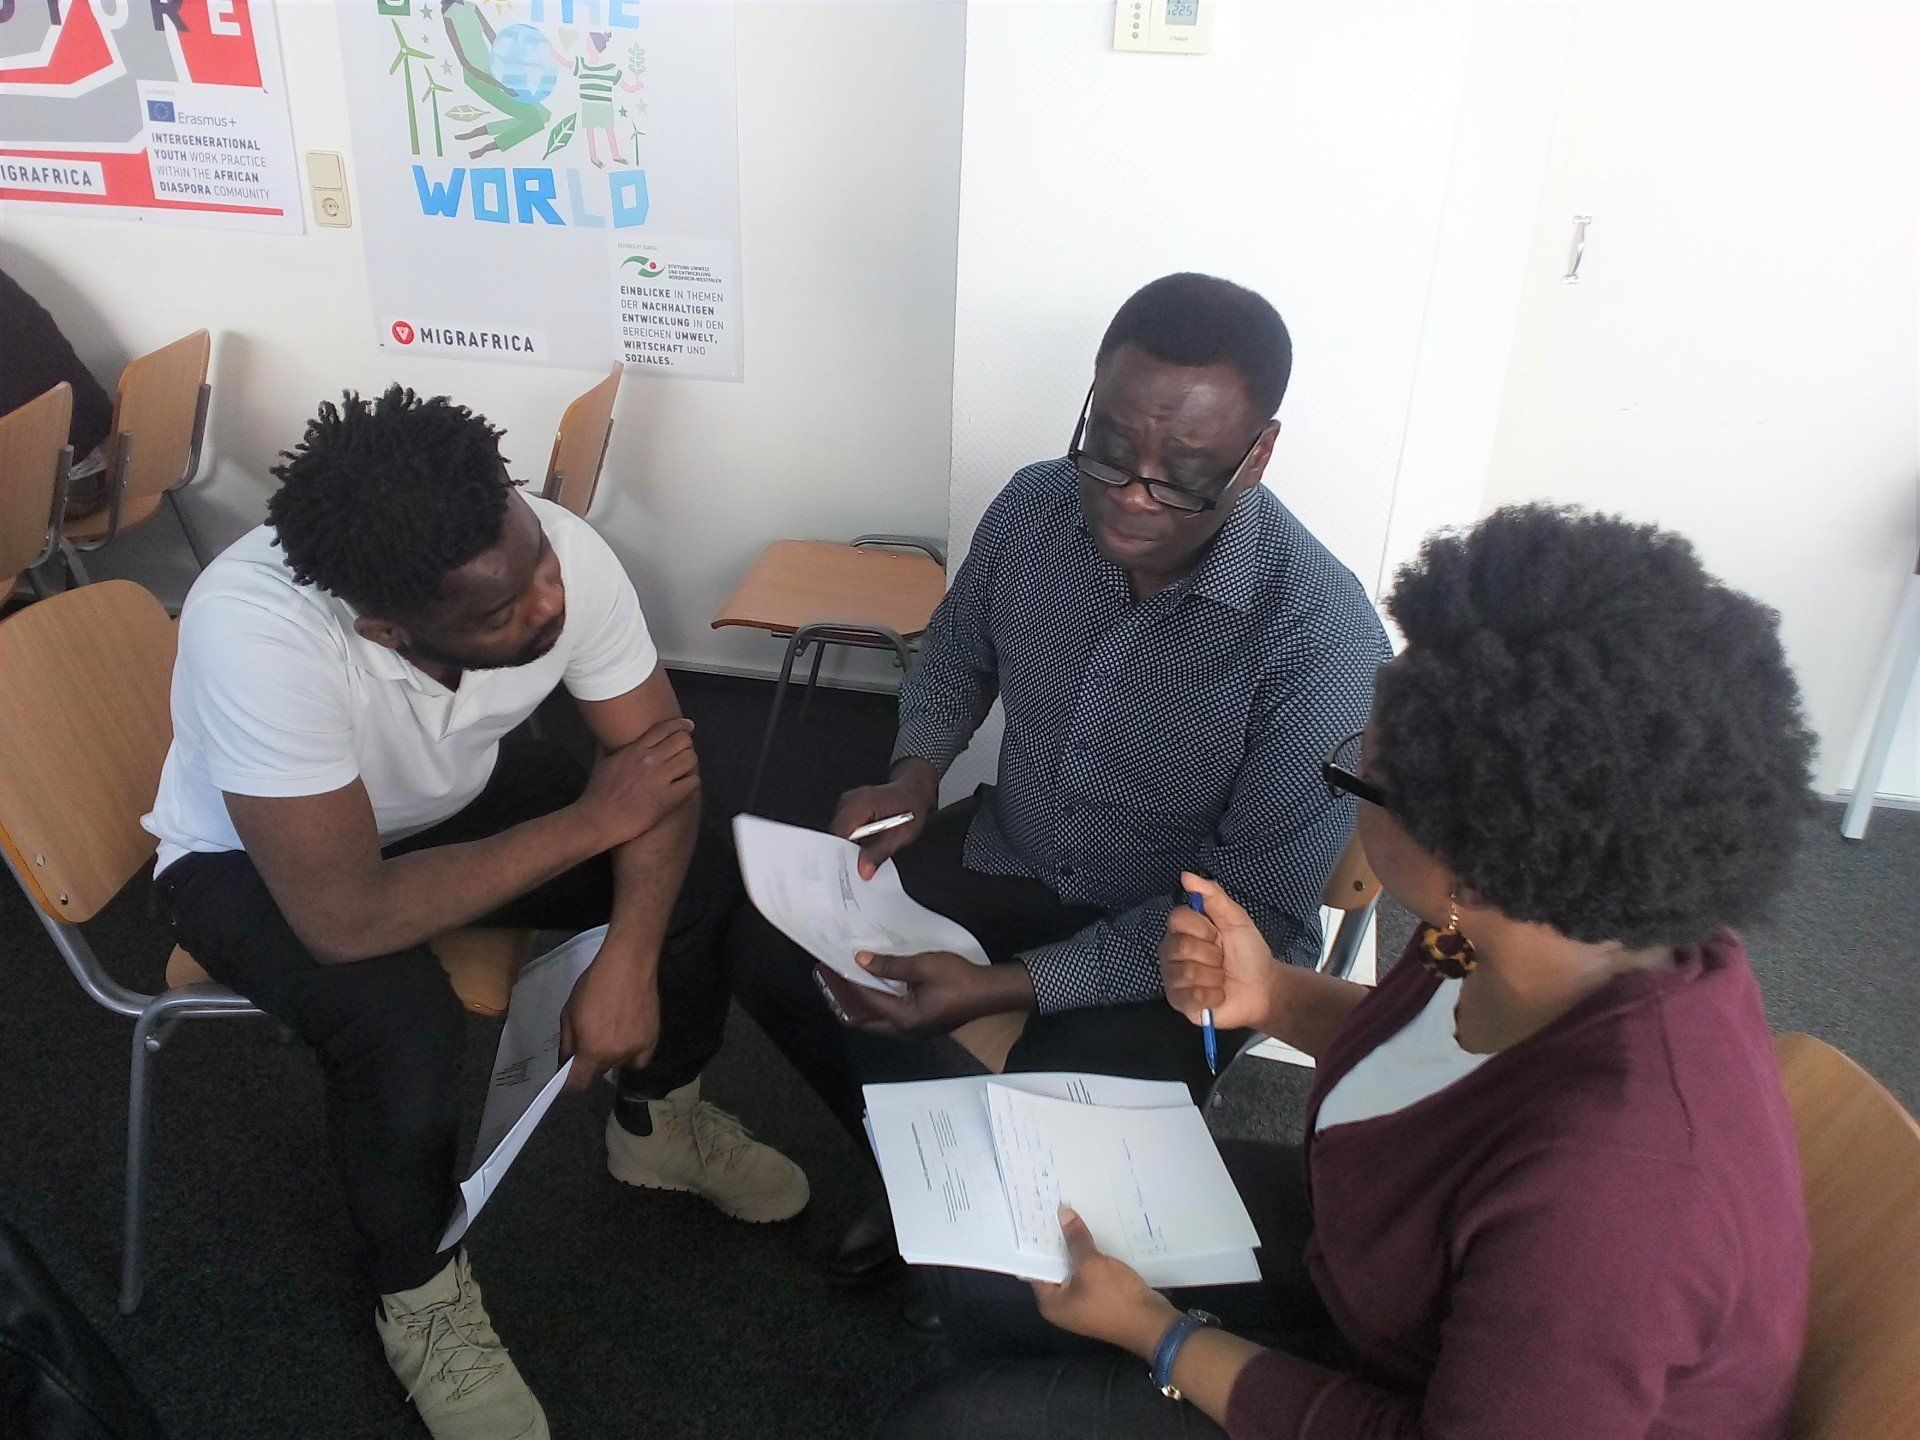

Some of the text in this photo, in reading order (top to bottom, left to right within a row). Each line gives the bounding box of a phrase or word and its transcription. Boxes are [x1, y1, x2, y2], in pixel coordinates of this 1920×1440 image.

[178, 112, 237, 127] Erasmus+
[151, 132, 261, 151] INTERGENERATIONAL
[154, 149, 267, 168] YOUTH WORK PRACTICE
[156, 165, 260, 183] WITHIN THE AFRICAN
[160, 181, 270, 200] DIASPORA COMMUNITY
[411, 164, 650, 229] WORLD
[620, 285, 724, 302] EINBLICKE IN THEMEN
[621, 299, 715, 315] DER NACHHALTIGEN
[622, 313, 724, 330] ENTWICKLUNG IN DEN
[420, 326, 536, 354] MIGRAFRICA
[622, 326, 718, 344] BEREICHEN UMWELT,
[623, 340, 706, 356] WIRTSCHAFT UND
[625, 353, 674, 366] SOZIALES.
